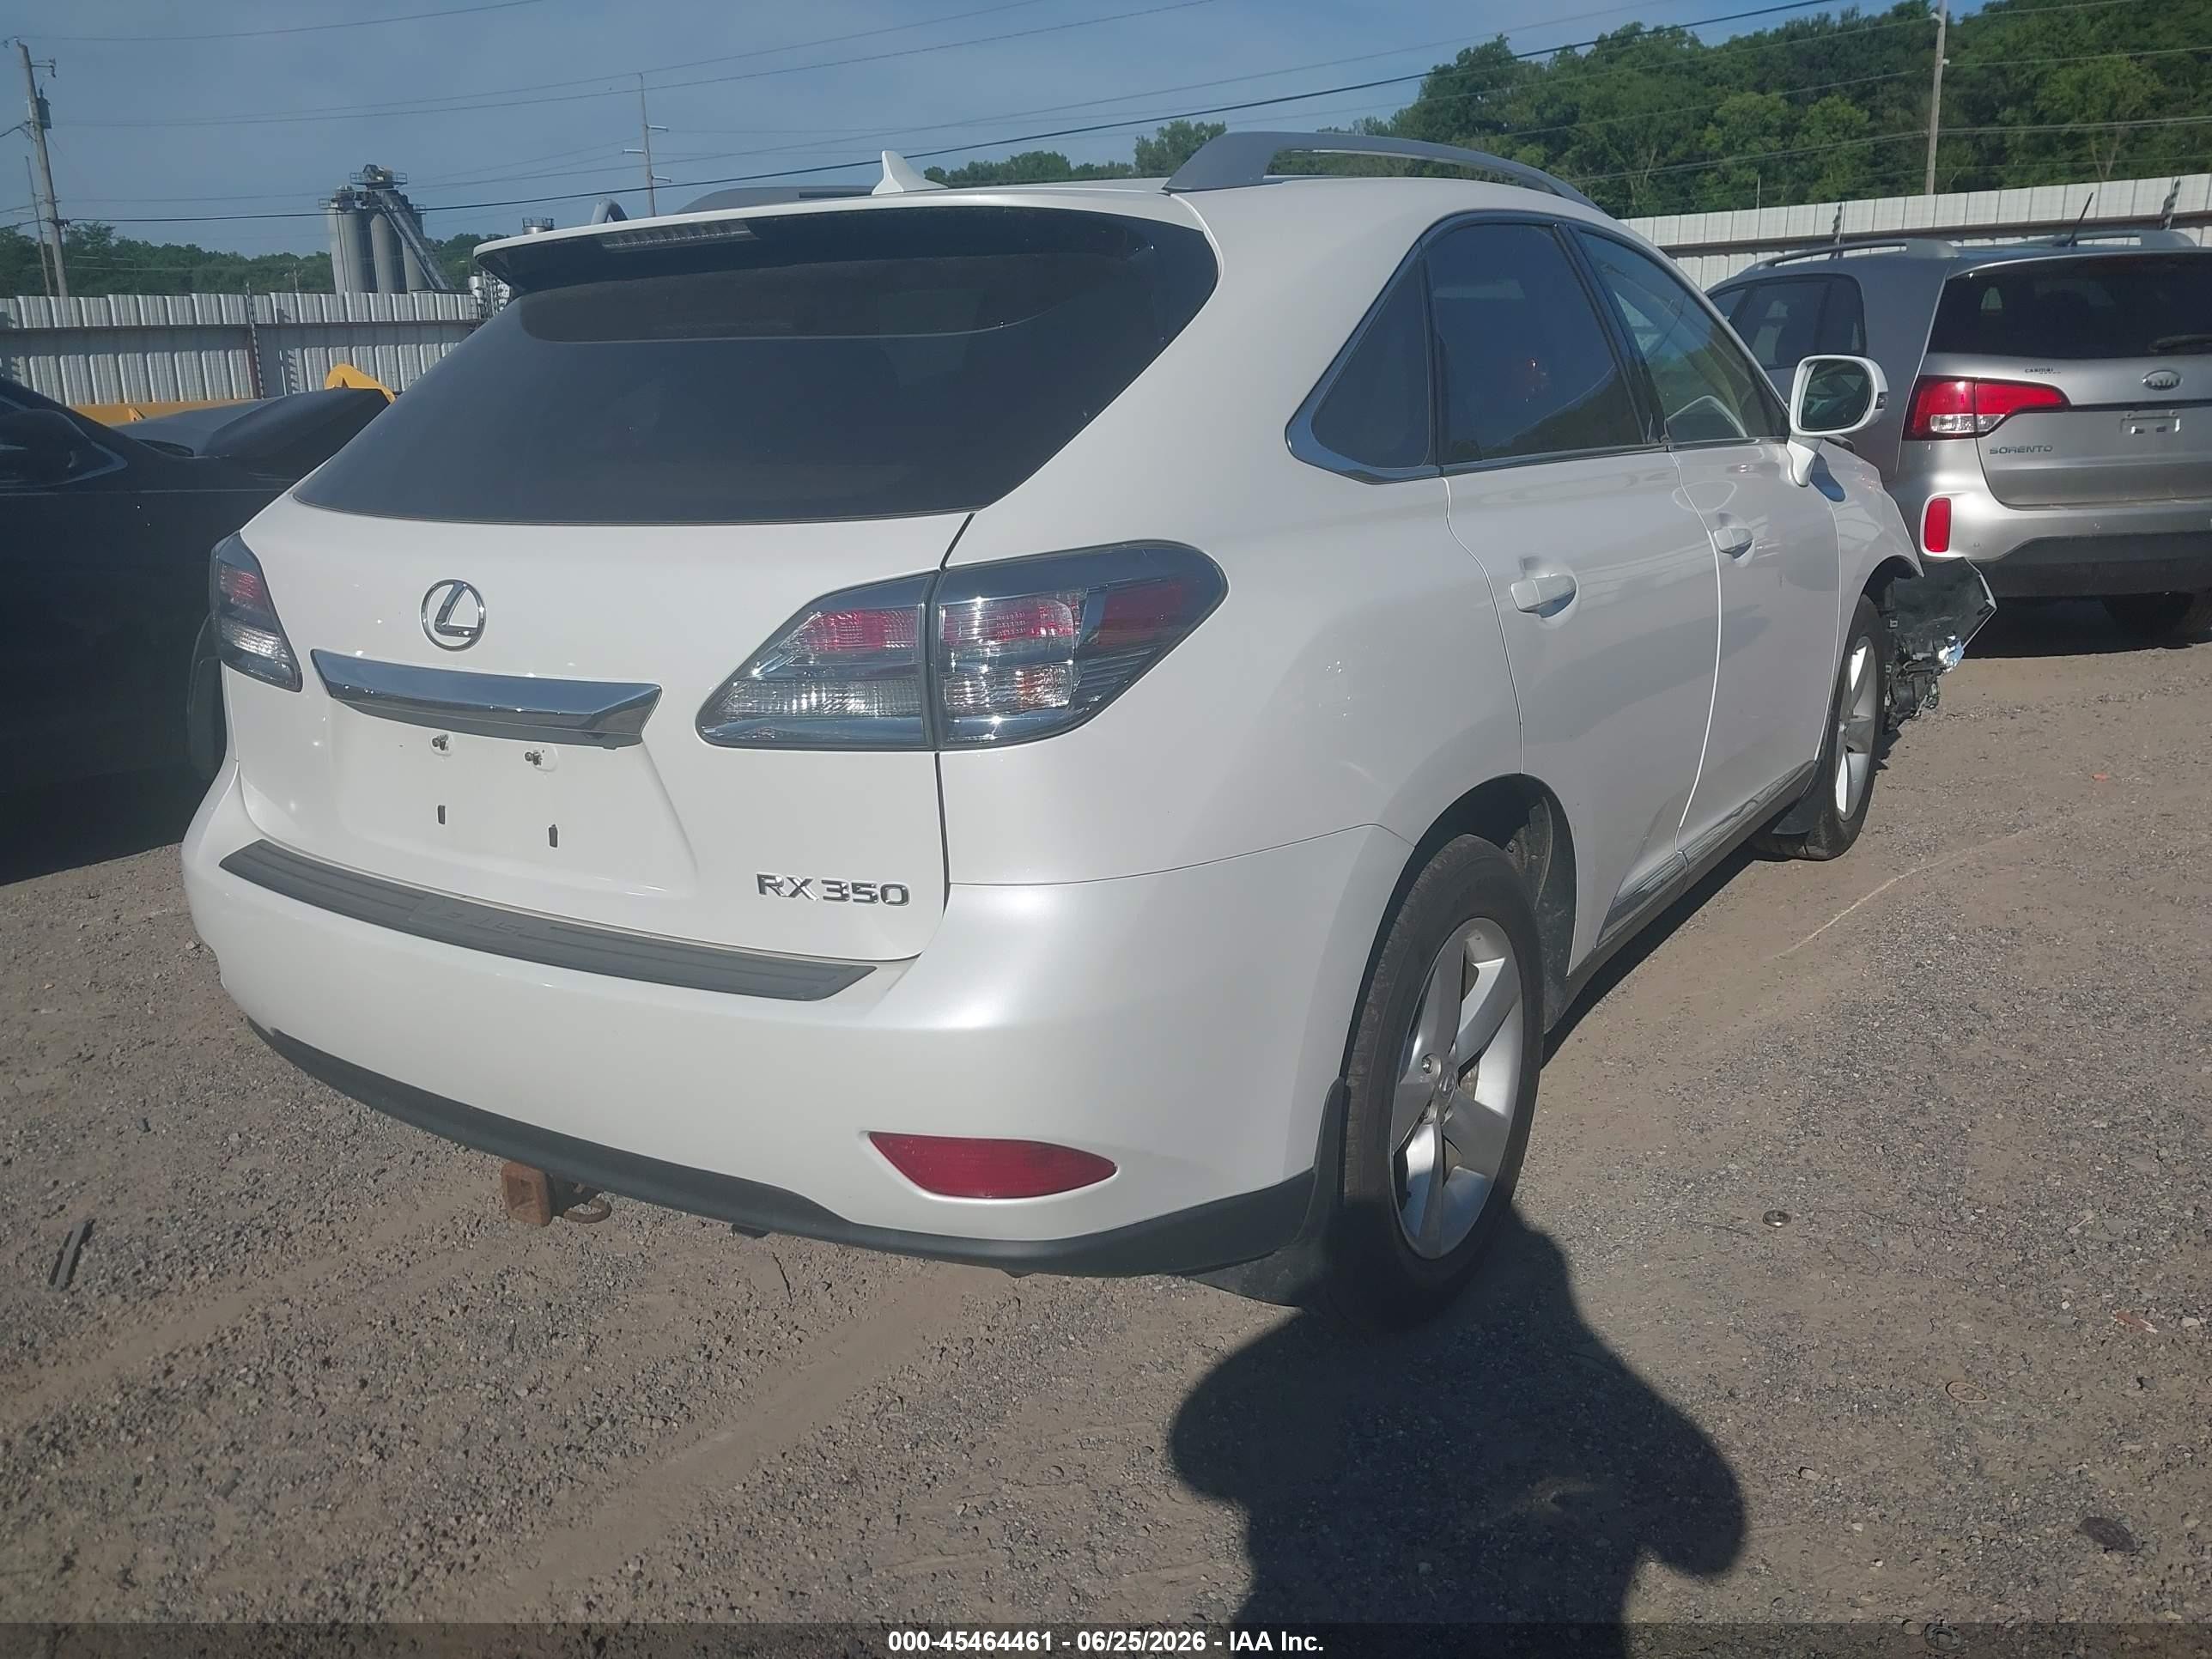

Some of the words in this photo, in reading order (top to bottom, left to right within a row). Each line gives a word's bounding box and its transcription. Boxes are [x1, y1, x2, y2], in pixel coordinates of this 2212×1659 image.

[1990, 445, 2053, 454] SORENTO
[757, 873, 818, 902] RX
[821, 879, 910, 907] 350
